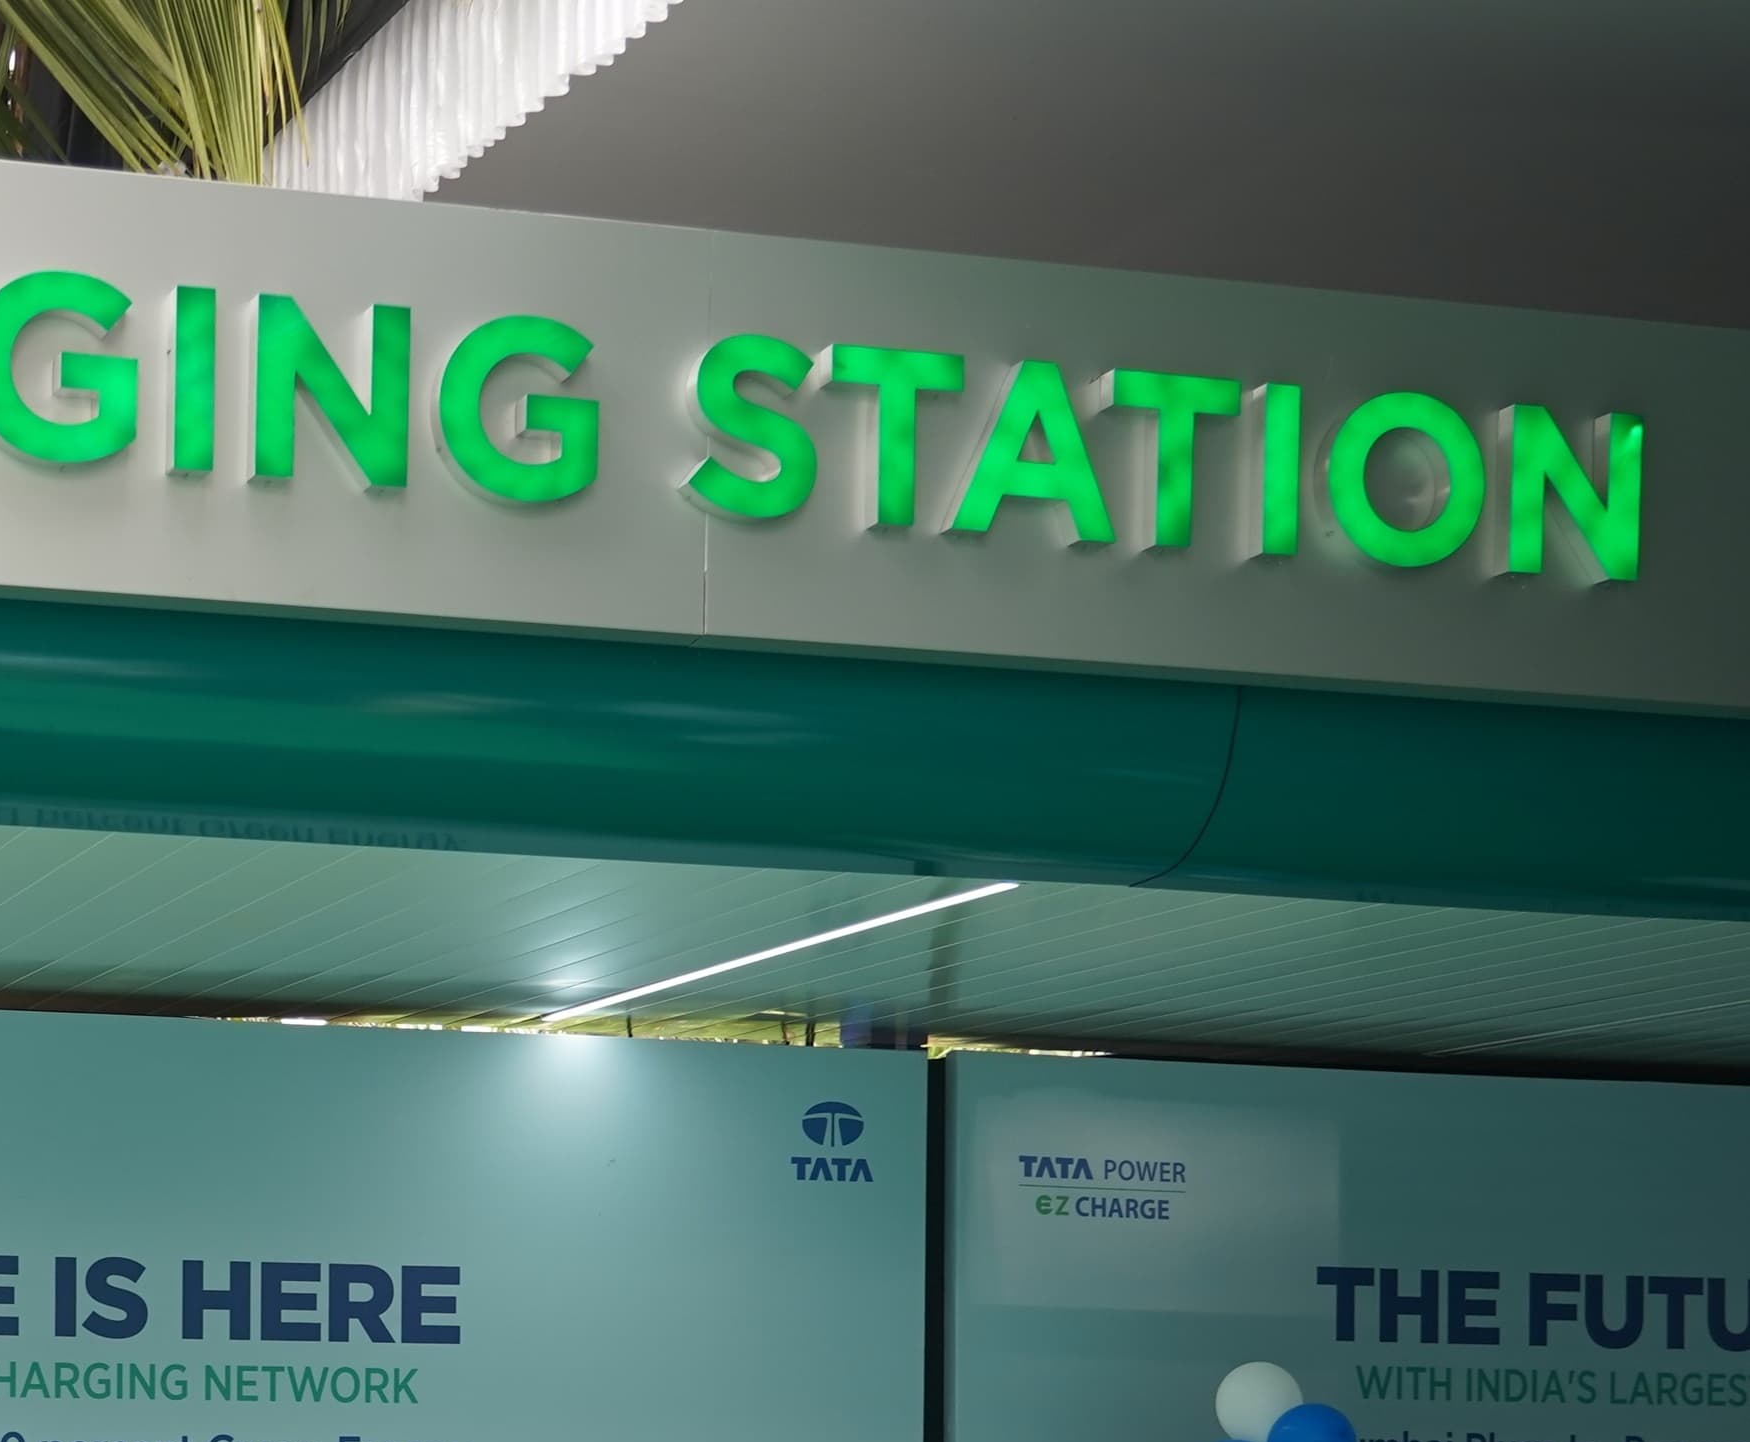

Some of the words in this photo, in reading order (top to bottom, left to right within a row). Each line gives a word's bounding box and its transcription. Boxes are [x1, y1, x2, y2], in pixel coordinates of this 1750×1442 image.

[684, 334, 1646, 583] STATION
[790, 1156, 874, 1183] TATA
[1019, 1155, 1093, 1181] TATA
[1103, 1159, 1187, 1184] POWER
[1075, 1196, 1171, 1220] CHARGE
[54, 1255, 149, 1340] IS
[181, 1259, 461, 1345] HERE
[1316, 1266, 1501, 1346] THE
[203, 1365, 419, 1404] NETWORK
[1355, 1365, 1451, 1401] WITH
[1465, 1367, 1597, 1405] INDIA'S
[1611, 1371, 1750, 1407] LARGES
